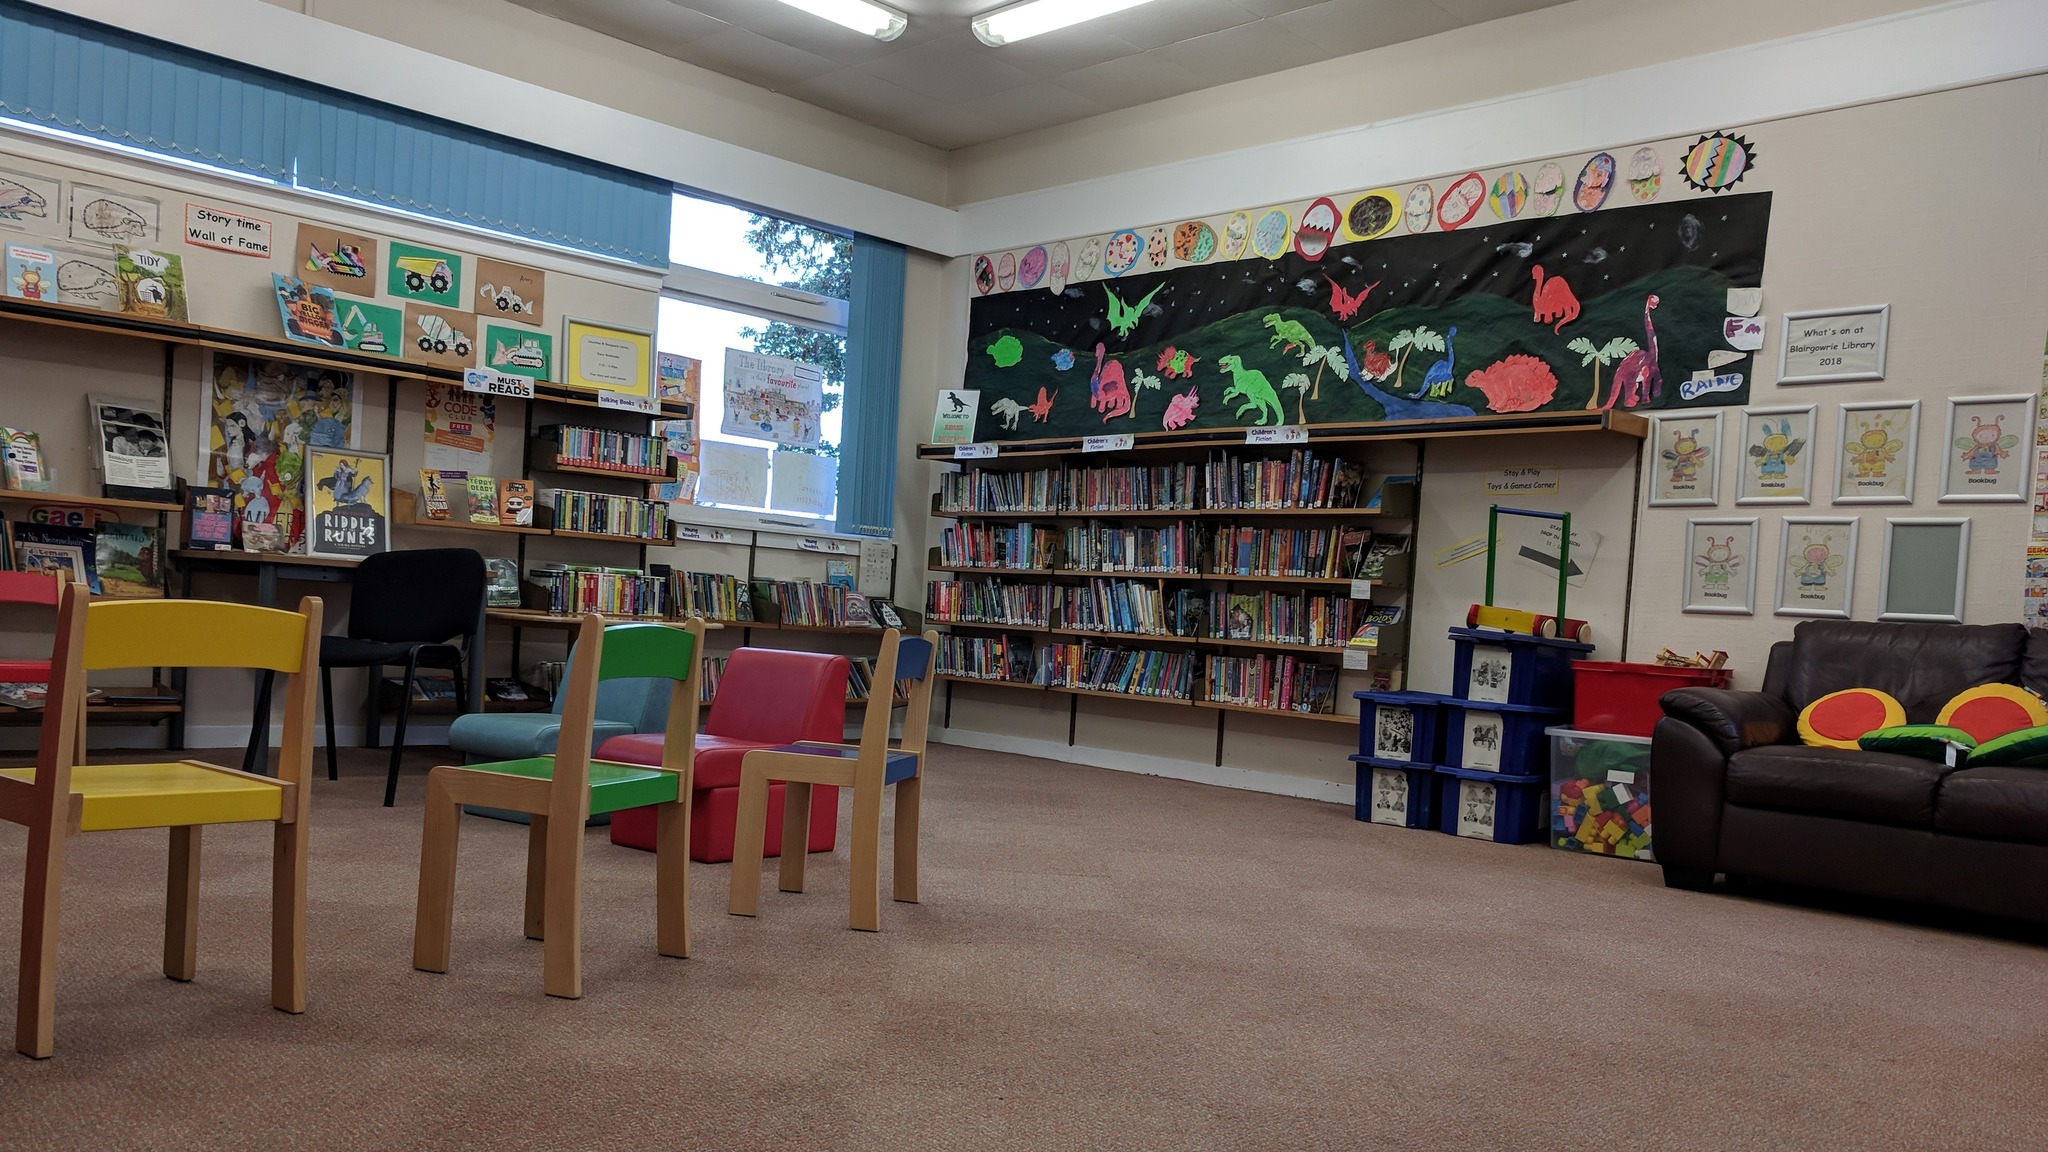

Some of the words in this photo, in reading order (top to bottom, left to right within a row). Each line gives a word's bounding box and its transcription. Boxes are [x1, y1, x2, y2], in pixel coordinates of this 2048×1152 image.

[197, 210, 231, 227] Story
[236, 218, 262, 231] time
[188, 227, 216, 242] Wall
[221, 235, 234, 245] of
[238, 237, 268, 252] Fame
[301, 303, 320, 314] BIG
[1804, 328, 1837, 337] What's
[1854, 326, 1864, 334] at
[1790, 343, 1839, 354] Blairgowrie
[1842, 341, 1876, 350] Library
[739, 354, 755, 369] The
[757, 358, 785, 379] library
[1819, 357, 1842, 366] 2018
[497, 376, 522, 385] MUST
[767, 373, 797, 389] favourite
[488, 383, 530, 396] READS
[600, 396, 618, 406] Talking
[620, 398, 635, 406] Books
[444, 401, 478, 416] CODE
[448, 413, 473, 421] CLUB
[1503, 469, 1519, 477] Stay
[1520, 468, 1526, 476] &
[1527, 468, 1541, 477] Play
[470, 478, 492, 486] TERRY
[1487, 482, 1502, 491] Toys
[1533, 481, 1556, 489] Corner
[324, 513, 375, 530] RIDDLE
[1540, 529, 1553, 537] DROP
[1549, 524, 1562, 532] STAY
[324, 529, 375, 545] RUNES
[1365, 615, 1393, 623] BOLDS
